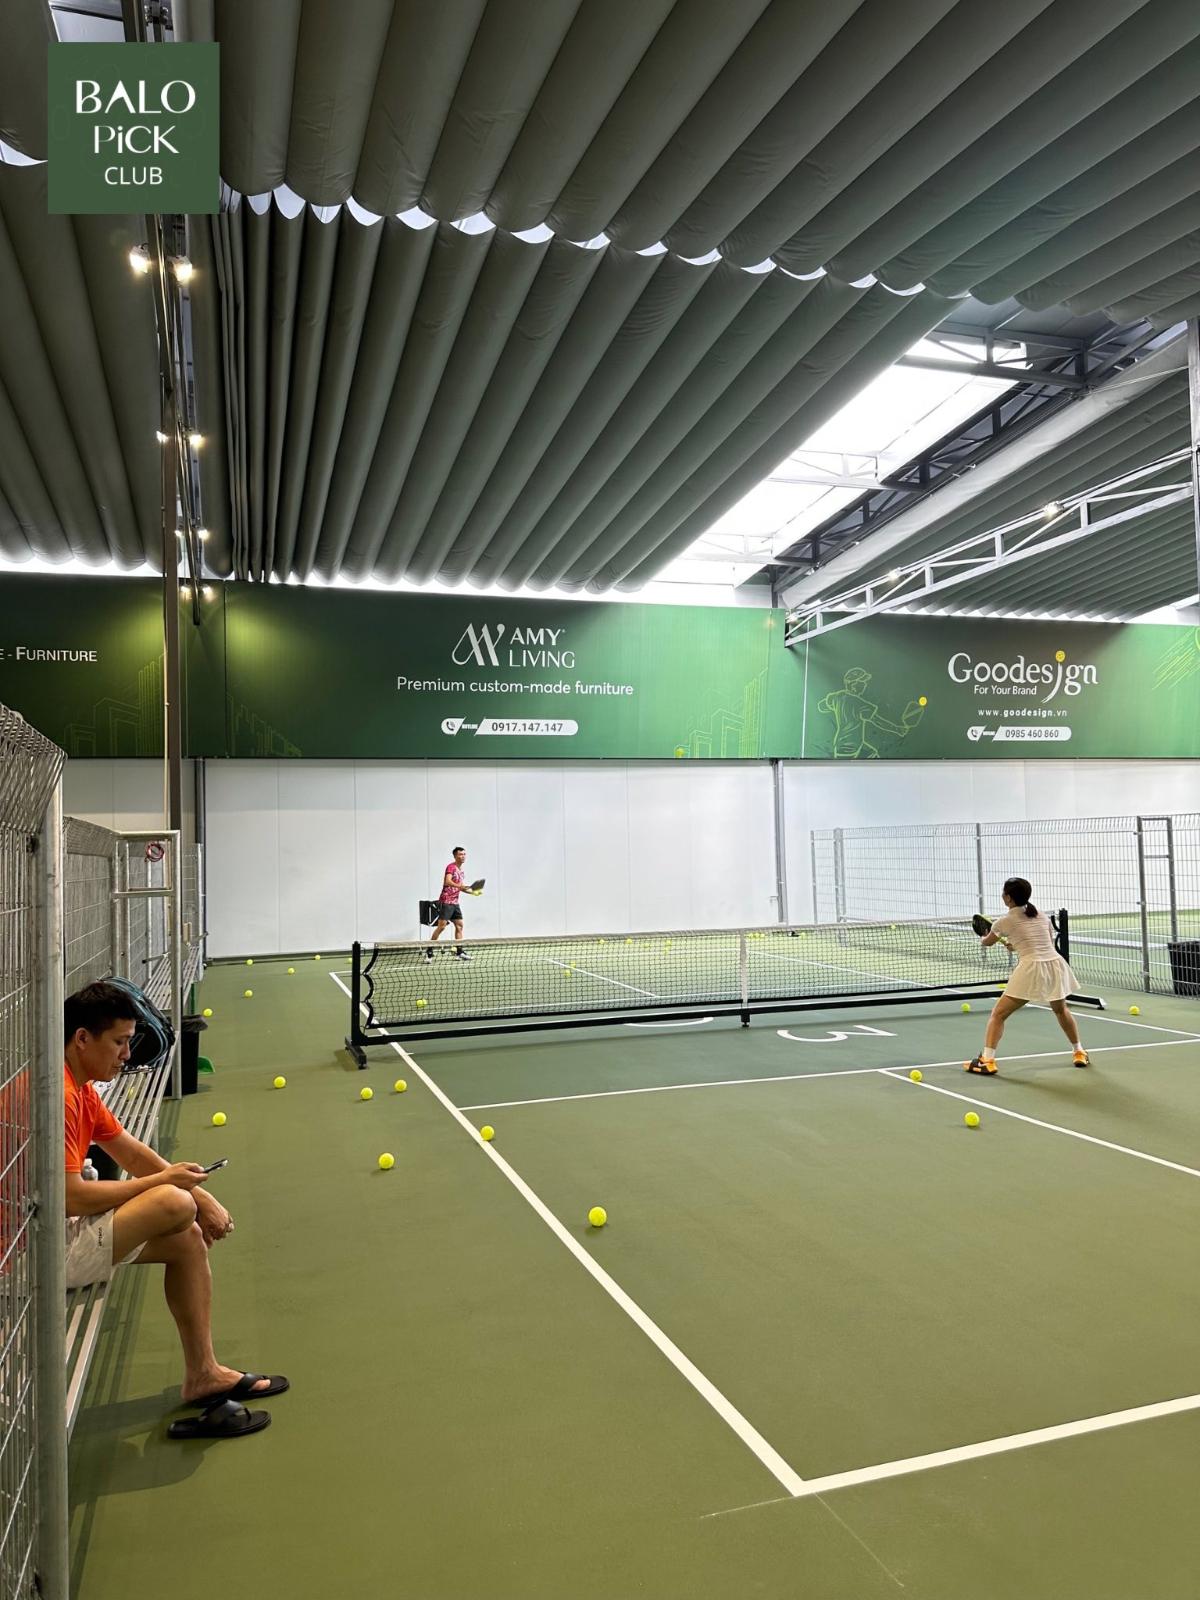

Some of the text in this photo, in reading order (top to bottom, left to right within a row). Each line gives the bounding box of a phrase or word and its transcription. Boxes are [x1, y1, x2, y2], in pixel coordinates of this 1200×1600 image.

[509, 627, 562, 646] AMY
[509, 649, 576, 669] LIVING
[947, 650, 1099, 704] Goodesign
[397, 676, 634, 696] Premium custom-made furniture
[974, 684, 1037, 696] For Your Brand
[977, 708, 1067, 718] www.goodesign.vn
[491, 721, 563, 733] 0917.147.147
[1005, 729, 1026, 738] 0985
